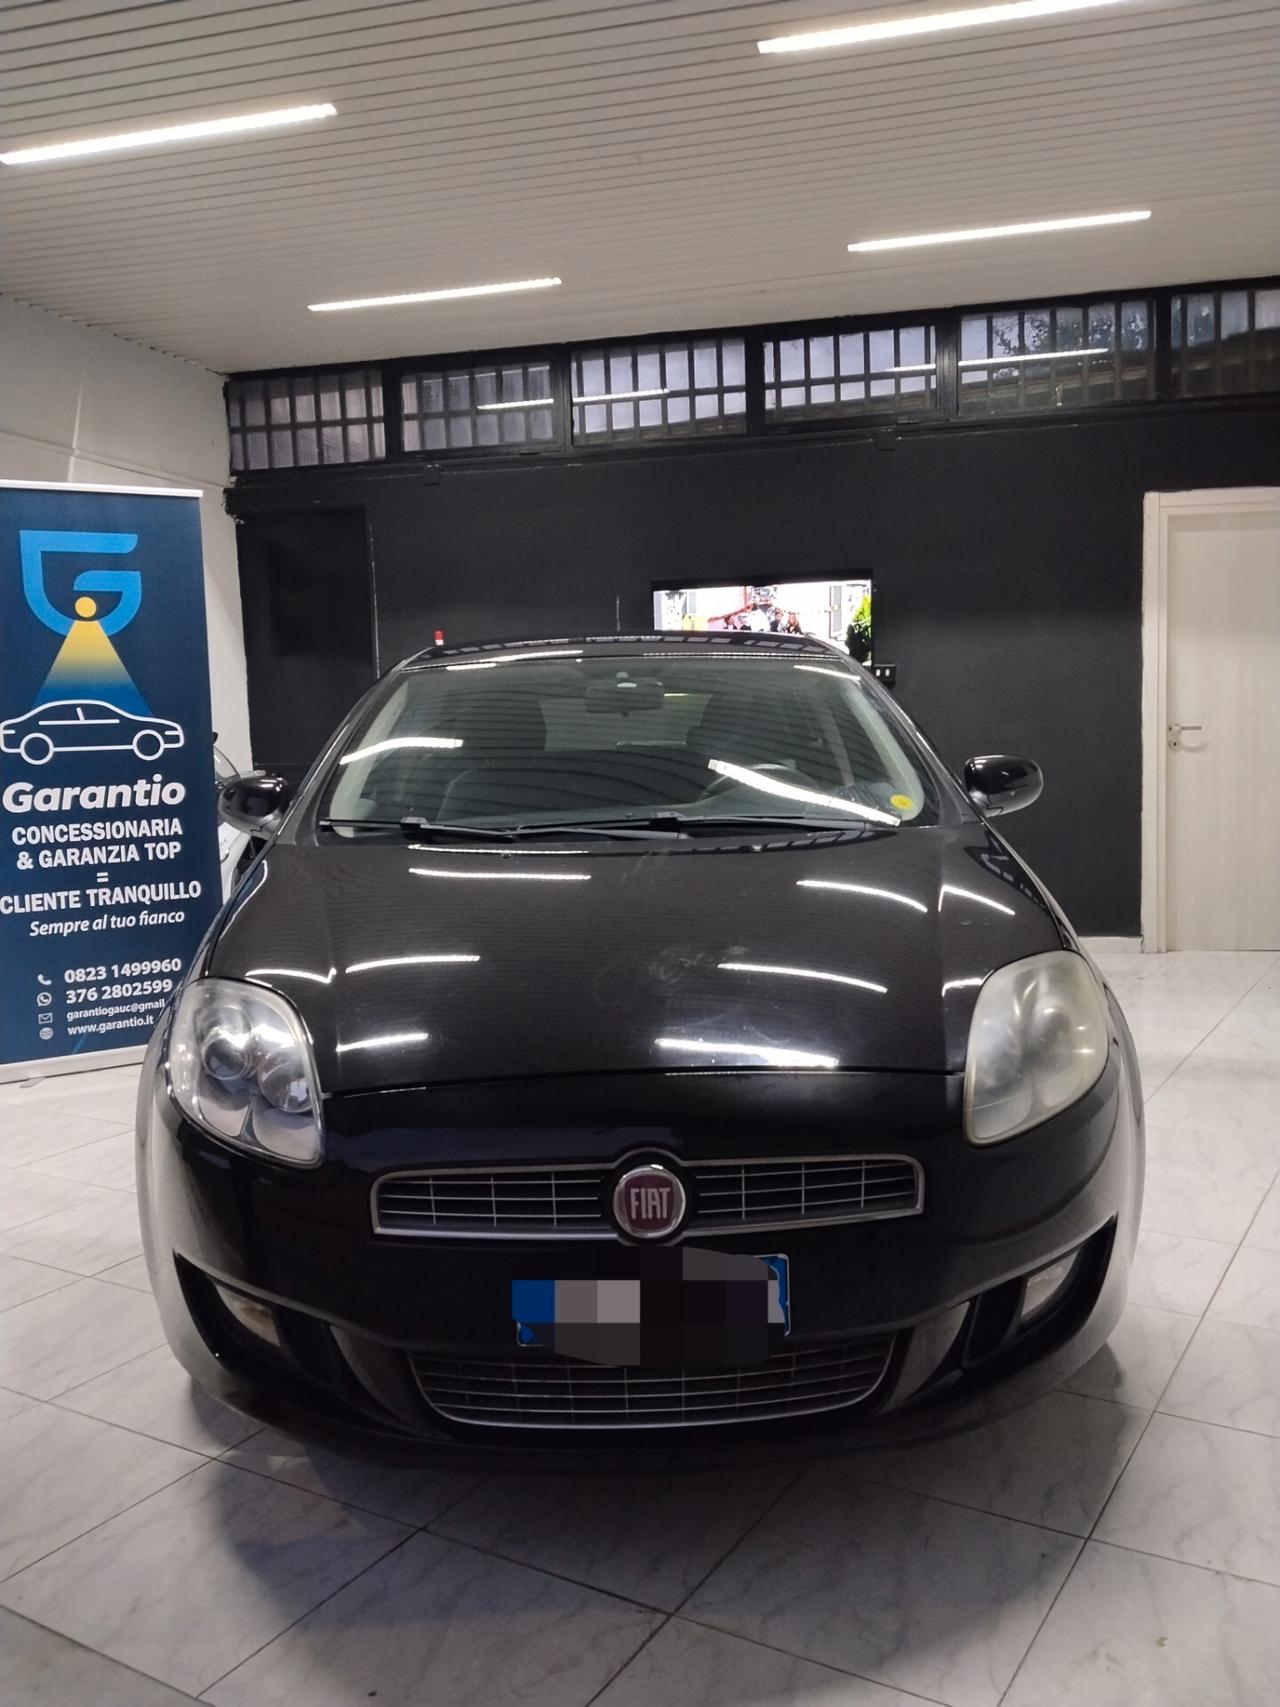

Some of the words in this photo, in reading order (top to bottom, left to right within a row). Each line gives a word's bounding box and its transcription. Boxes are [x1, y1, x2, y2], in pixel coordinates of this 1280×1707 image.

[3, 774, 185, 813] Garantio
[12, 818, 183, 845] CONCESSIONARIA
[17, 851, 34, 869] &
[39, 844, 140, 868] GARANZIA
[144, 841, 181, 860] TOP
[0, 890, 80, 914] CLIENTE
[86, 881, 201, 906] TRANQUILLO
[29, 921, 89, 936] Sempre
[92, 914, 107, 930] al
[110, 915, 136, 928] tuo
[139, 910, 185, 926] fianco
[64, 966, 107, 983] 0823
[111, 958, 182, 978] 1499960
[66, 987, 98, 1004] 376
[101, 979, 173, 1000] 2802599
[67, 1015, 154, 1035] www.garantio.it
[630, 1187, 671, 1219] FIAT
